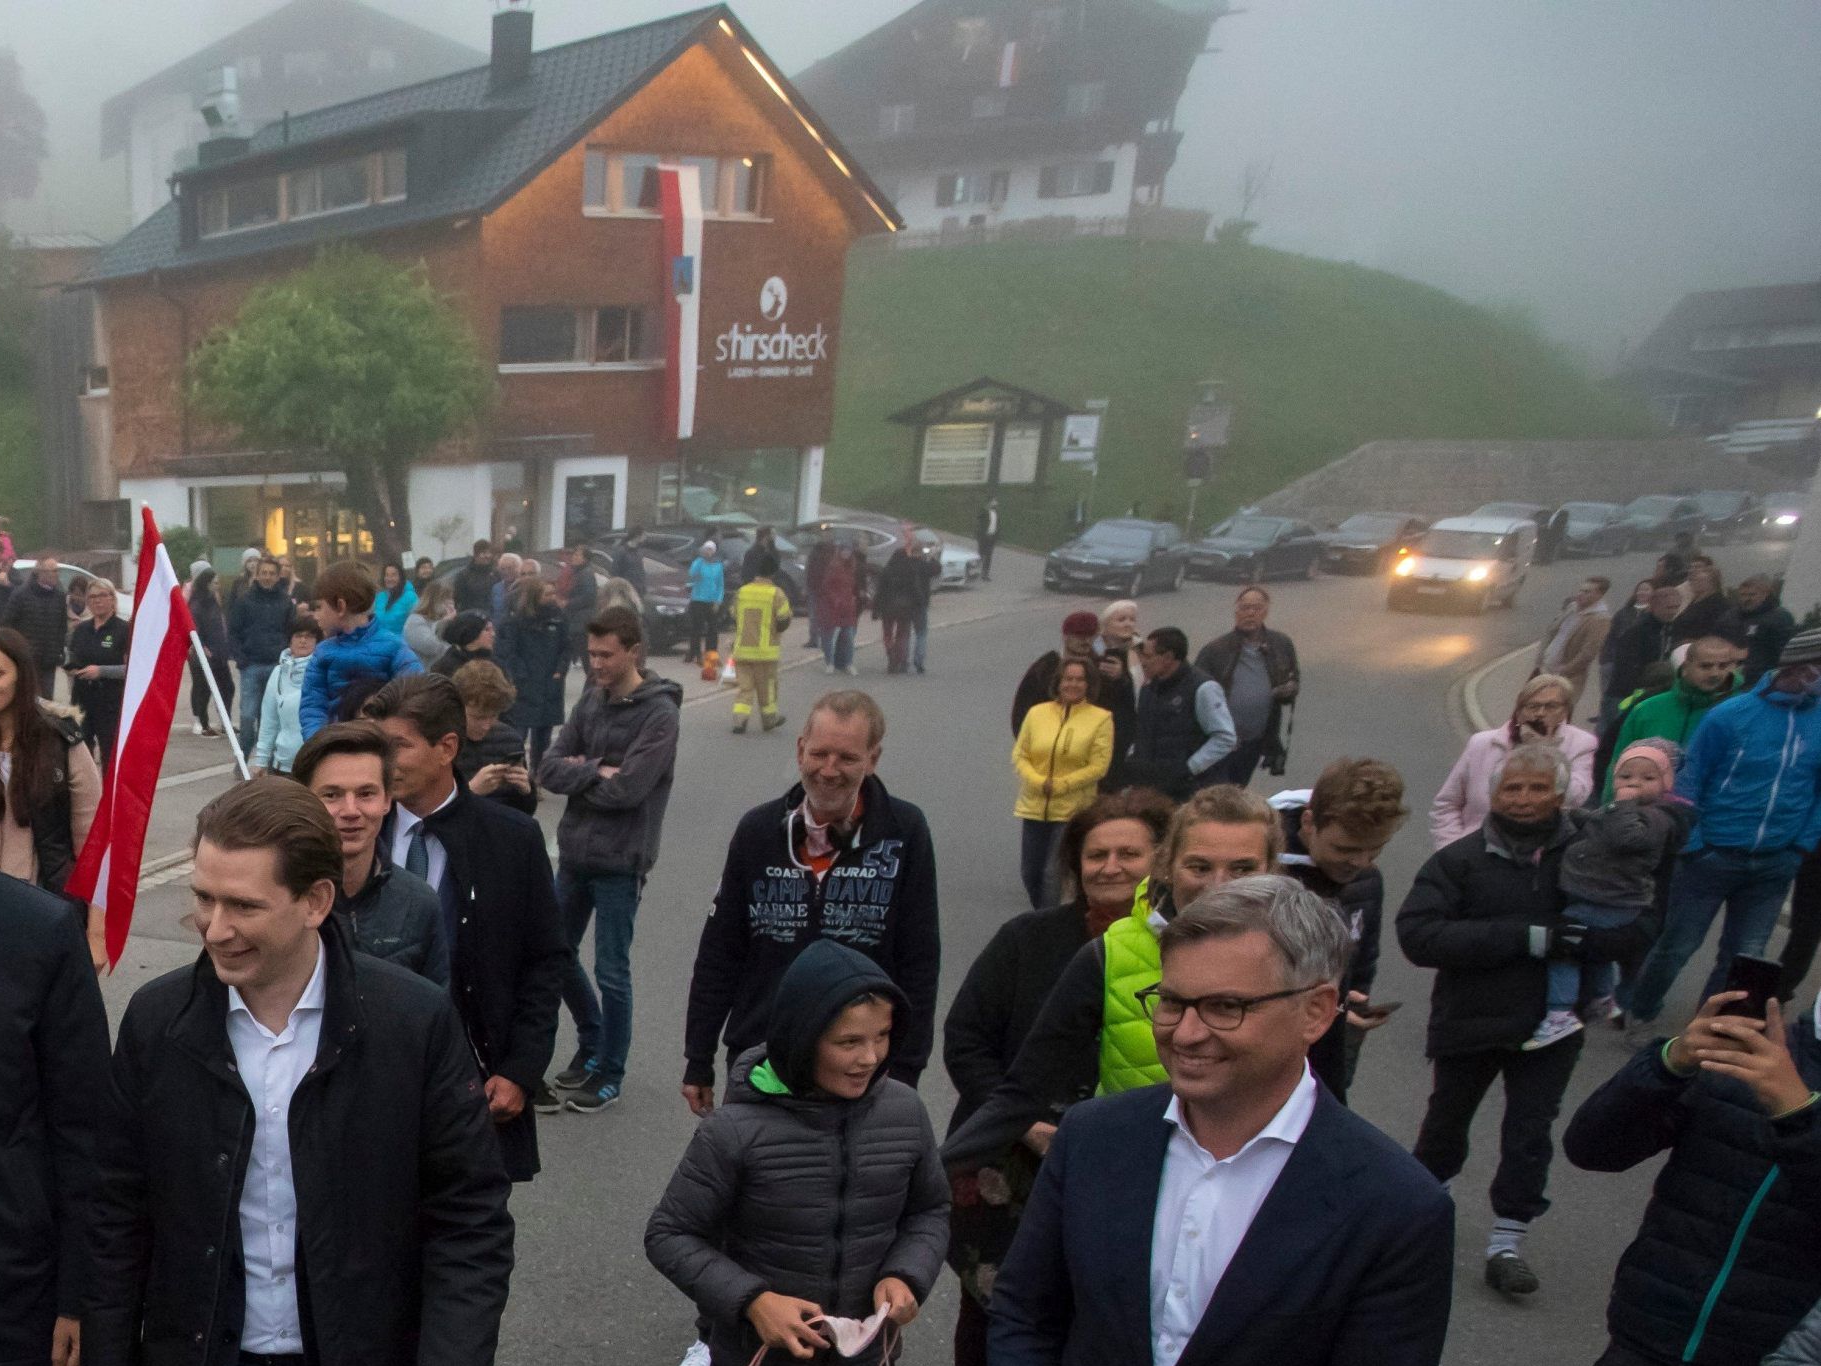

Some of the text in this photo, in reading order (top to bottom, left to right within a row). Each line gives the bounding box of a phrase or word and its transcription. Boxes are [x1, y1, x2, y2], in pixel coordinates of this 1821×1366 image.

[765, 866, 806, 879] COAST
[753, 878, 894, 903] CAMP DAVID
